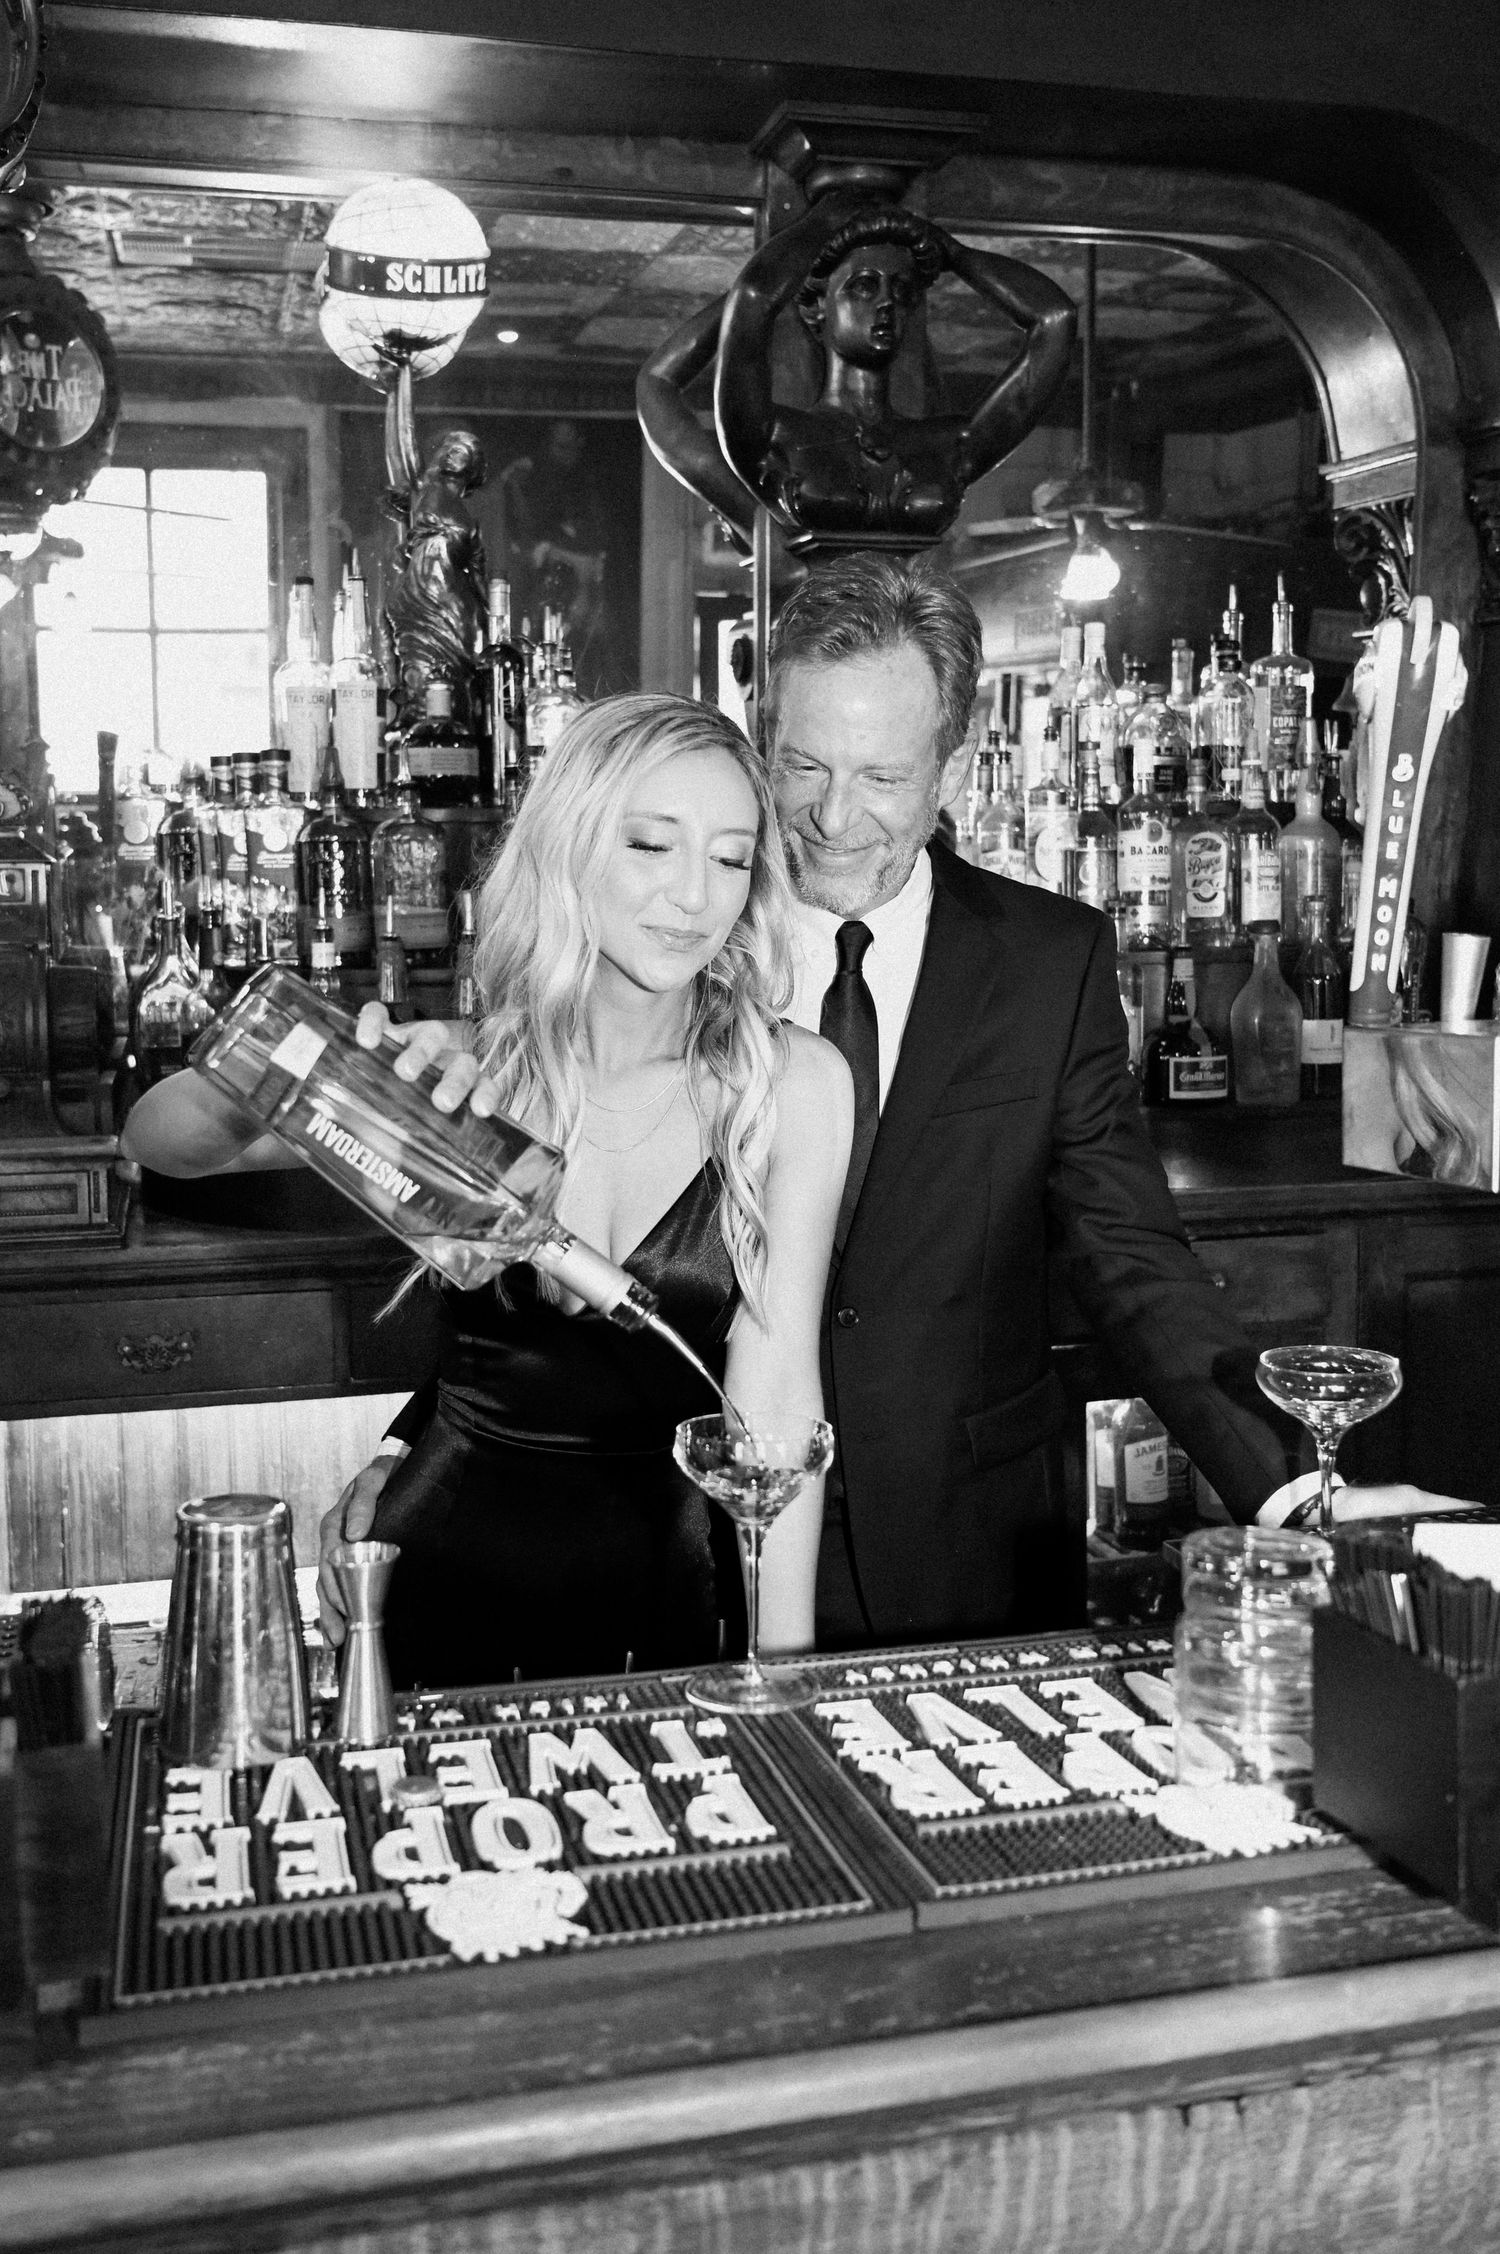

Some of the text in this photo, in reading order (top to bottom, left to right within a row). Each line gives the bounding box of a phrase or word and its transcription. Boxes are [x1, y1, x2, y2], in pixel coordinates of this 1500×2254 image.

[386, 262, 486, 293] SCHLITZ
[338, 689, 375, 699] TAYOR
[1371, 753, 1415, 972] BLUE MOON
[305, 1112, 420, 1203] AMSTERDAM
[162, 1720, 731, 1833] TWELVE
[161, 1773, 778, 1910] PROPER
